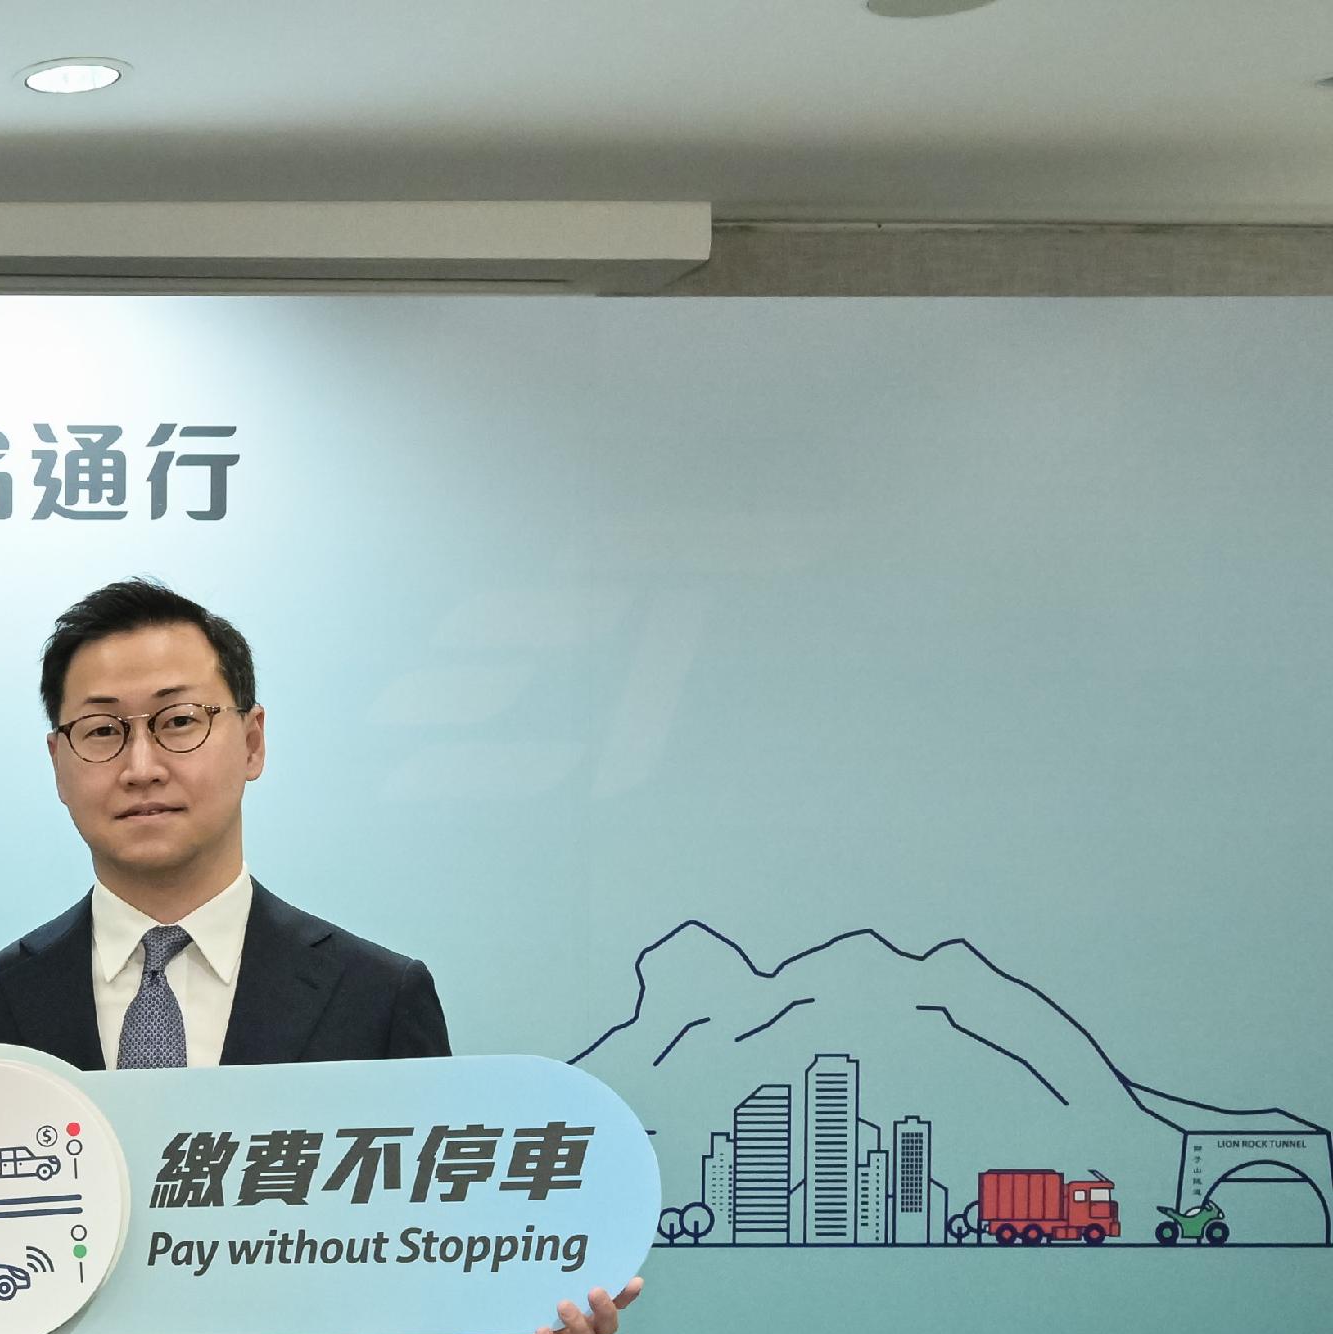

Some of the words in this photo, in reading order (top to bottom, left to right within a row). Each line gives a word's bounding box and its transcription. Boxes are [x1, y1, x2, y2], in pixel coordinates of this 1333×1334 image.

[148, 1121, 597, 1208] 繳費不停車
[1217, 1140, 1241, 1149] LION
[1242, 1140, 1268, 1149] ROCK
[1270, 1140, 1307, 1149] TUNNEL
[147, 1231, 219, 1277] Pay
[228, 1227, 389, 1268] without
[396, 1224, 589, 1273] Stopping
